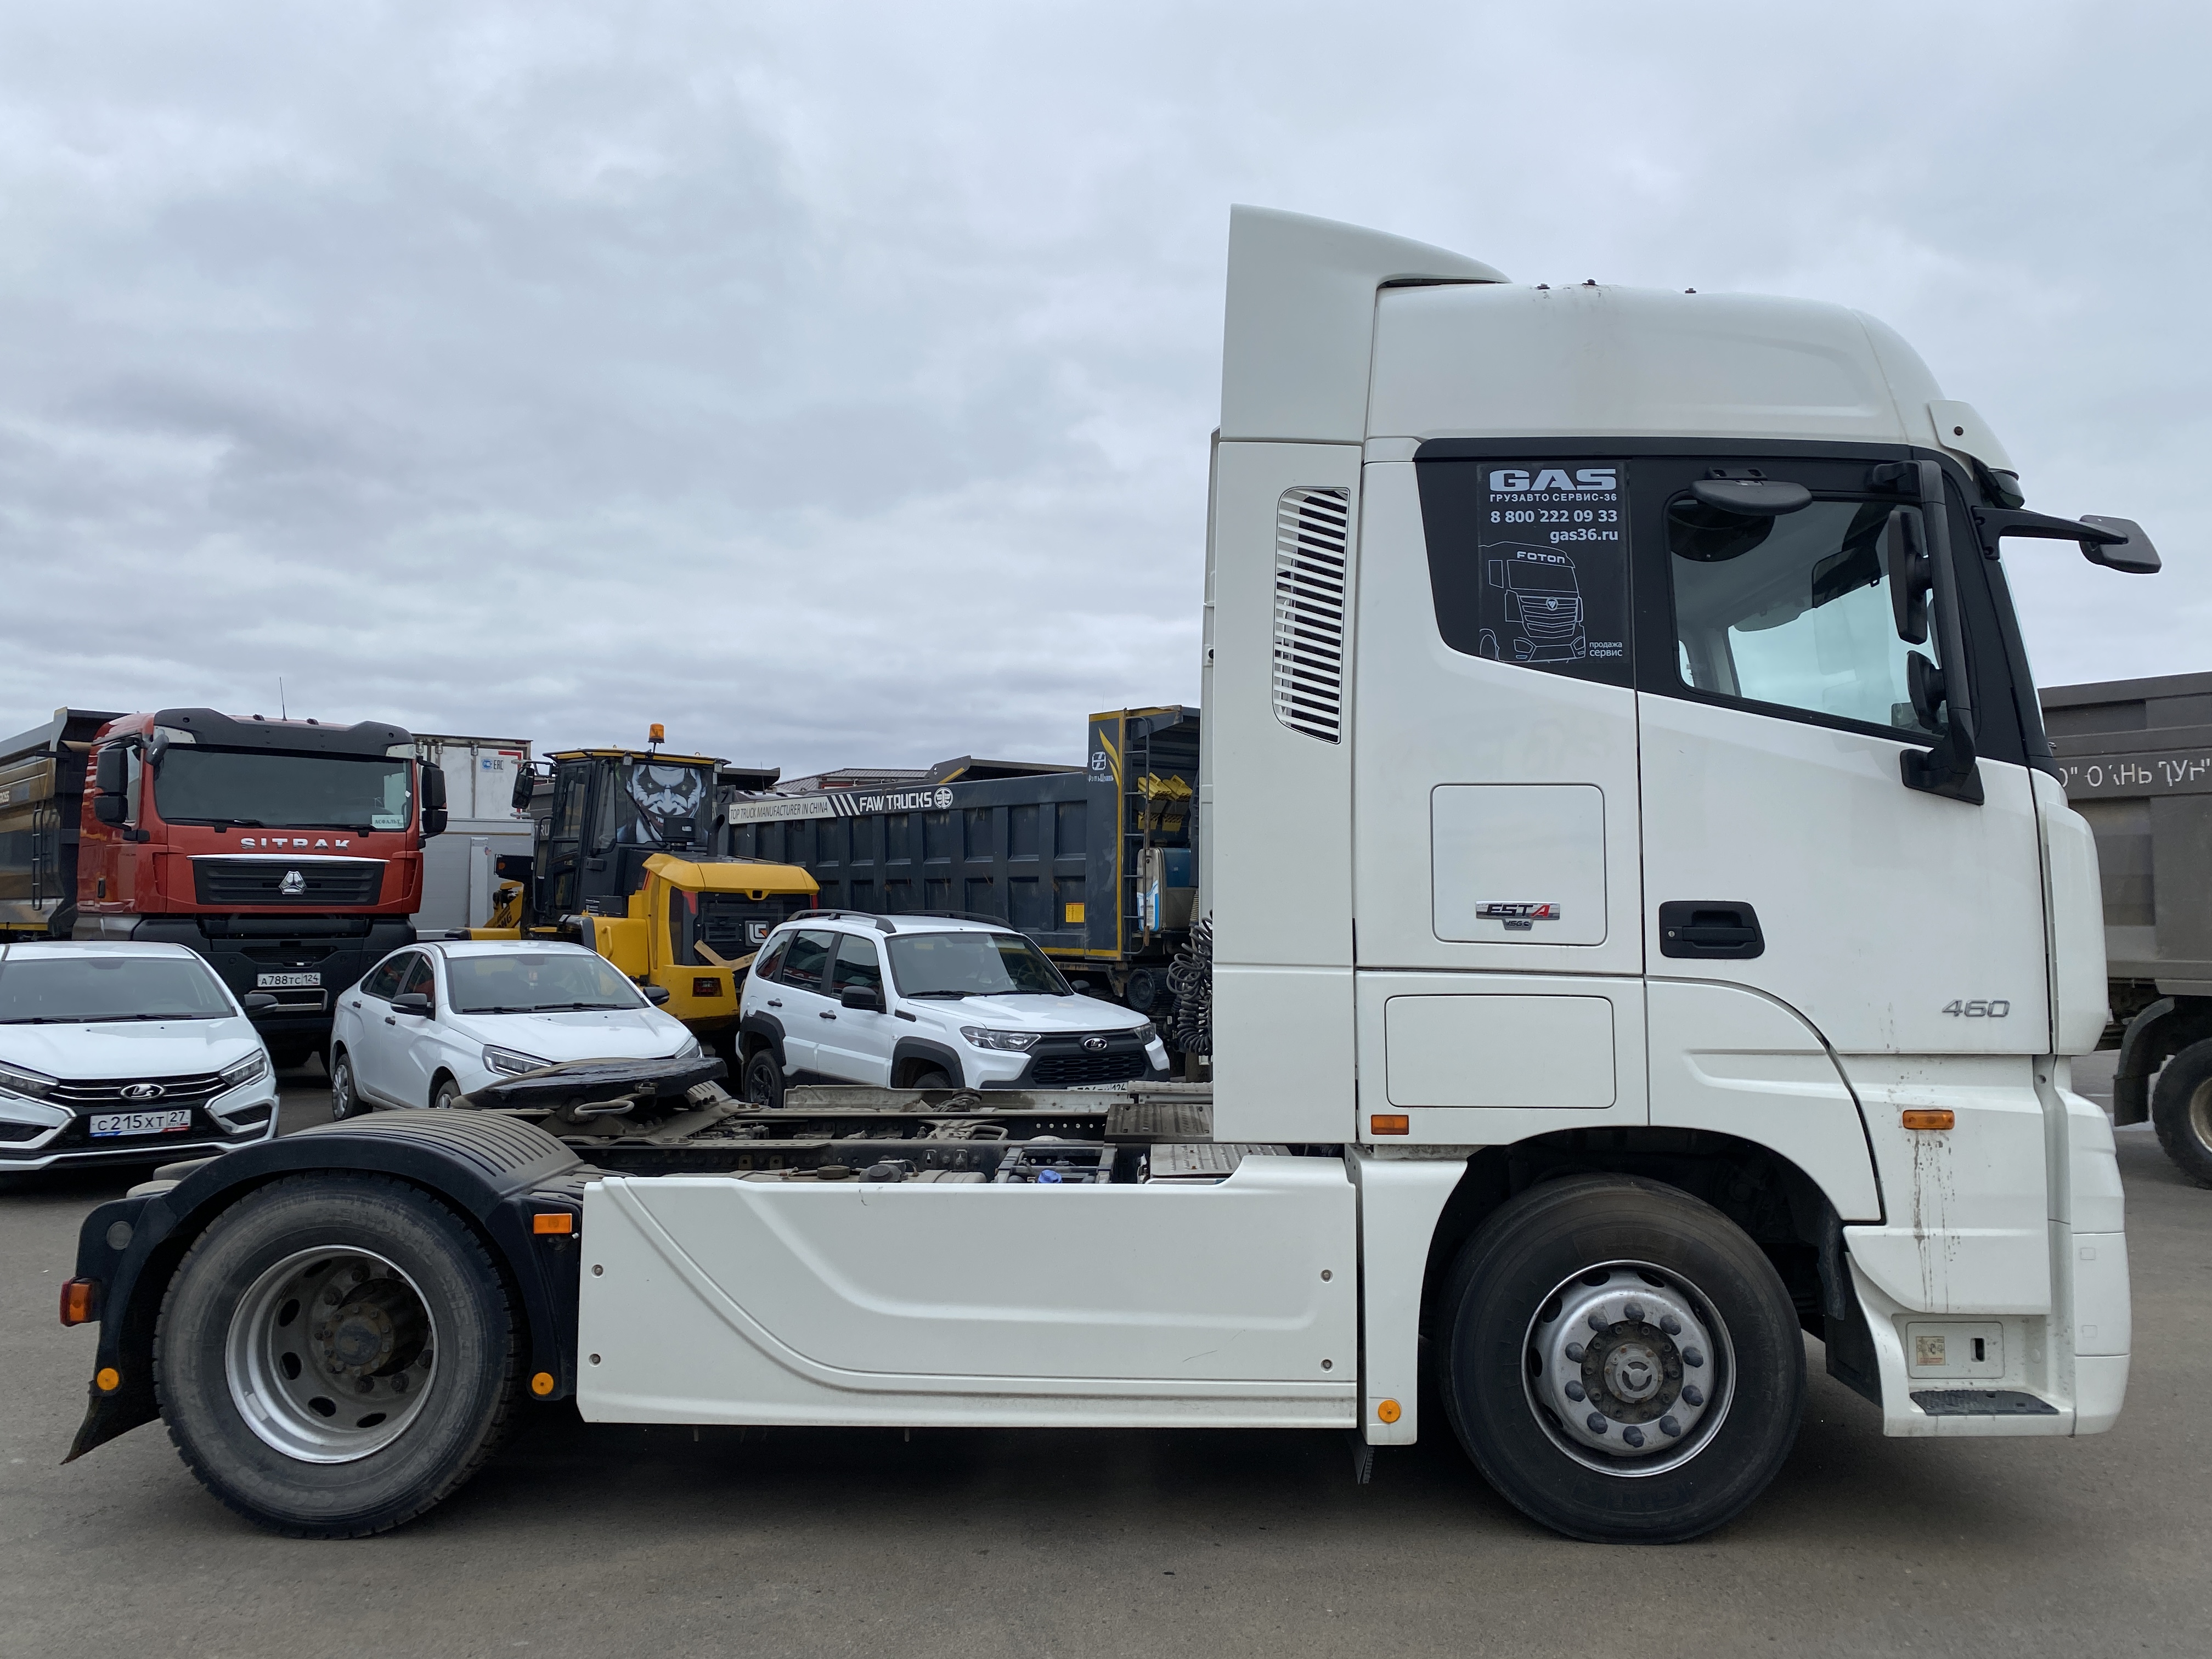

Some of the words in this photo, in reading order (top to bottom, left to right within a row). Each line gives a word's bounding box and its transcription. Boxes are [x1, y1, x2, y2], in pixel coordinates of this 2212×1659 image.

[1489, 469, 1617, 492] GAS
[1489, 494, 1550, 502] ГРУЗАВТО
[1552, 493, 1617, 502] СЕРВИС-36
[1490, 511, 1500, 523] 8
[1505, 510, 1535, 523] 800
[1539, 510, 1570, 522] 222
[1573, 510, 1593, 522] 09
[1598, 509, 1617, 522] 33
[1550, 528, 1618, 544] gas36.ru
[1589, 650, 1623, 658] сервис
[859, 795, 885, 812] FAW
[886, 792, 932, 810] TRUCKS
[730, 809, 740, 820] TOP
[741, 807, 756, 819] TRUCK
[757, 803, 800, 817] MANUFACTURER
[802, 803, 809, 814] IN
[809, 801, 828, 814] CHINA
[240, 838, 351, 850] SITRAK
[1486, 904, 1550, 917] ESTA
[1942, 999, 2010, 1017] 460
[170, 1111, 185, 1122] 27
